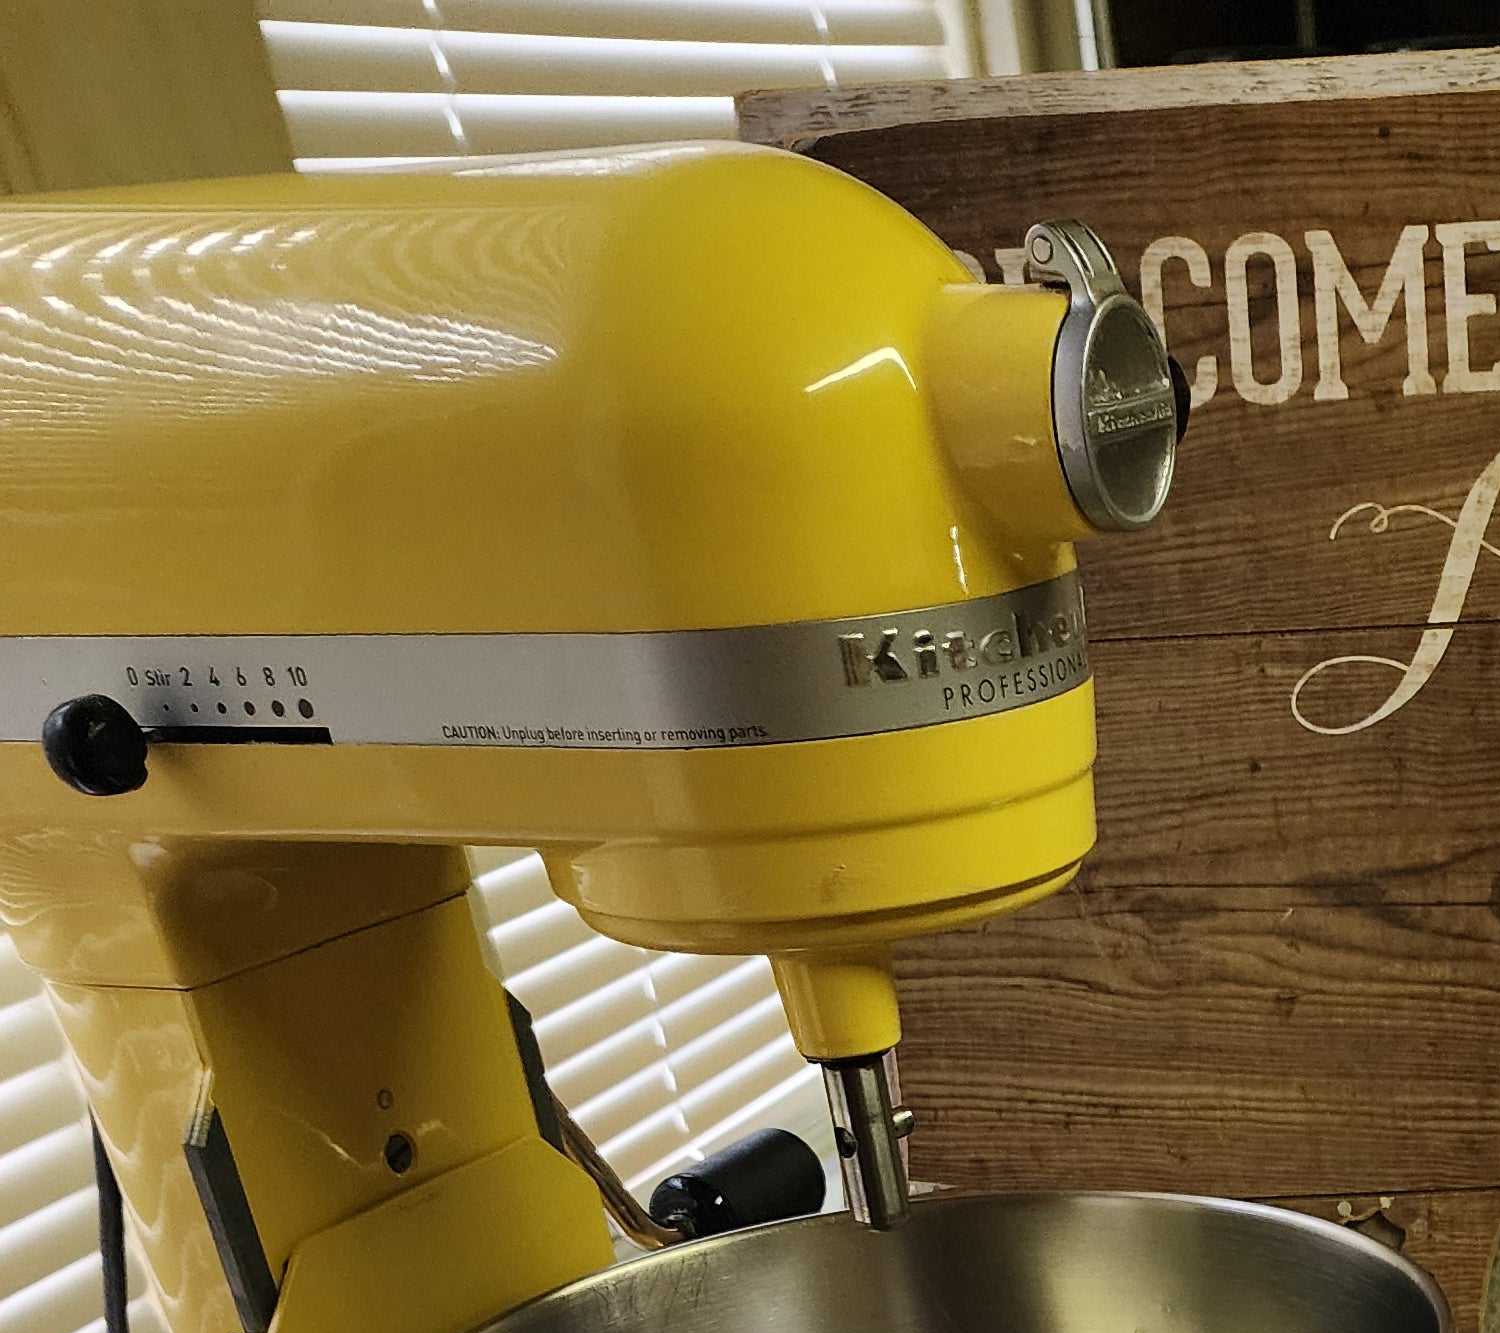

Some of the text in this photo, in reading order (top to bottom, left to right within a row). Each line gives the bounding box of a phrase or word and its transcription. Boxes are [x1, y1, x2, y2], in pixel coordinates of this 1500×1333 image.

[145, 668, 171, 687] Stir
[179, 666, 193, 687] 2
[208, 666, 220, 687] 4
[236, 666, 248, 687] 6
[262, 666, 276, 687] 8
[287, 666, 308, 687] 10
[442, 725, 501, 741] CAUTION:
[501, 726, 546, 744] Unplug
[547, 725, 584, 742] before
[586, 727, 642, 745] inserting
[644, 731, 658, 742] or
[660, 726, 726, 744] removing
